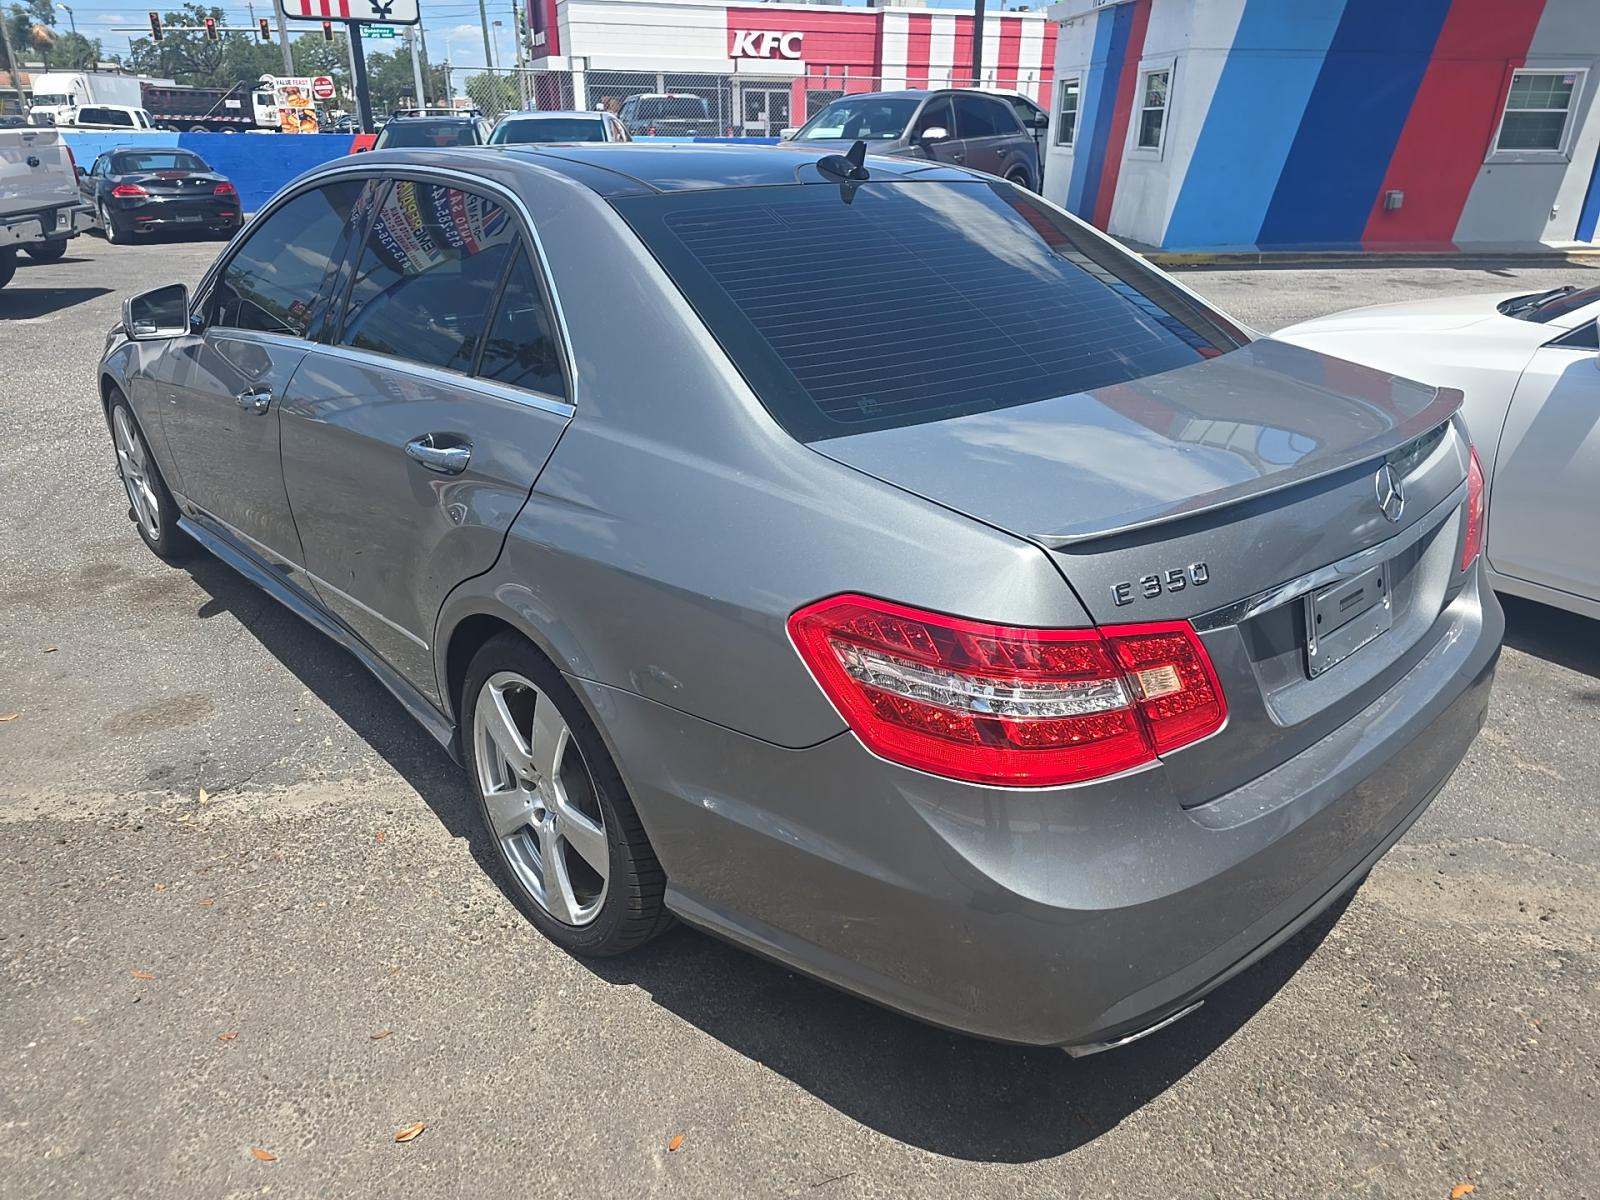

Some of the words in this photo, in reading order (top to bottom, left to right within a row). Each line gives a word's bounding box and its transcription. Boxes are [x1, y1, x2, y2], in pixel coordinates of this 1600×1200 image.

[729, 30, 804, 58] KFC
[1110, 581, 1135, 607] E
[1140, 562, 1209, 599] 350
